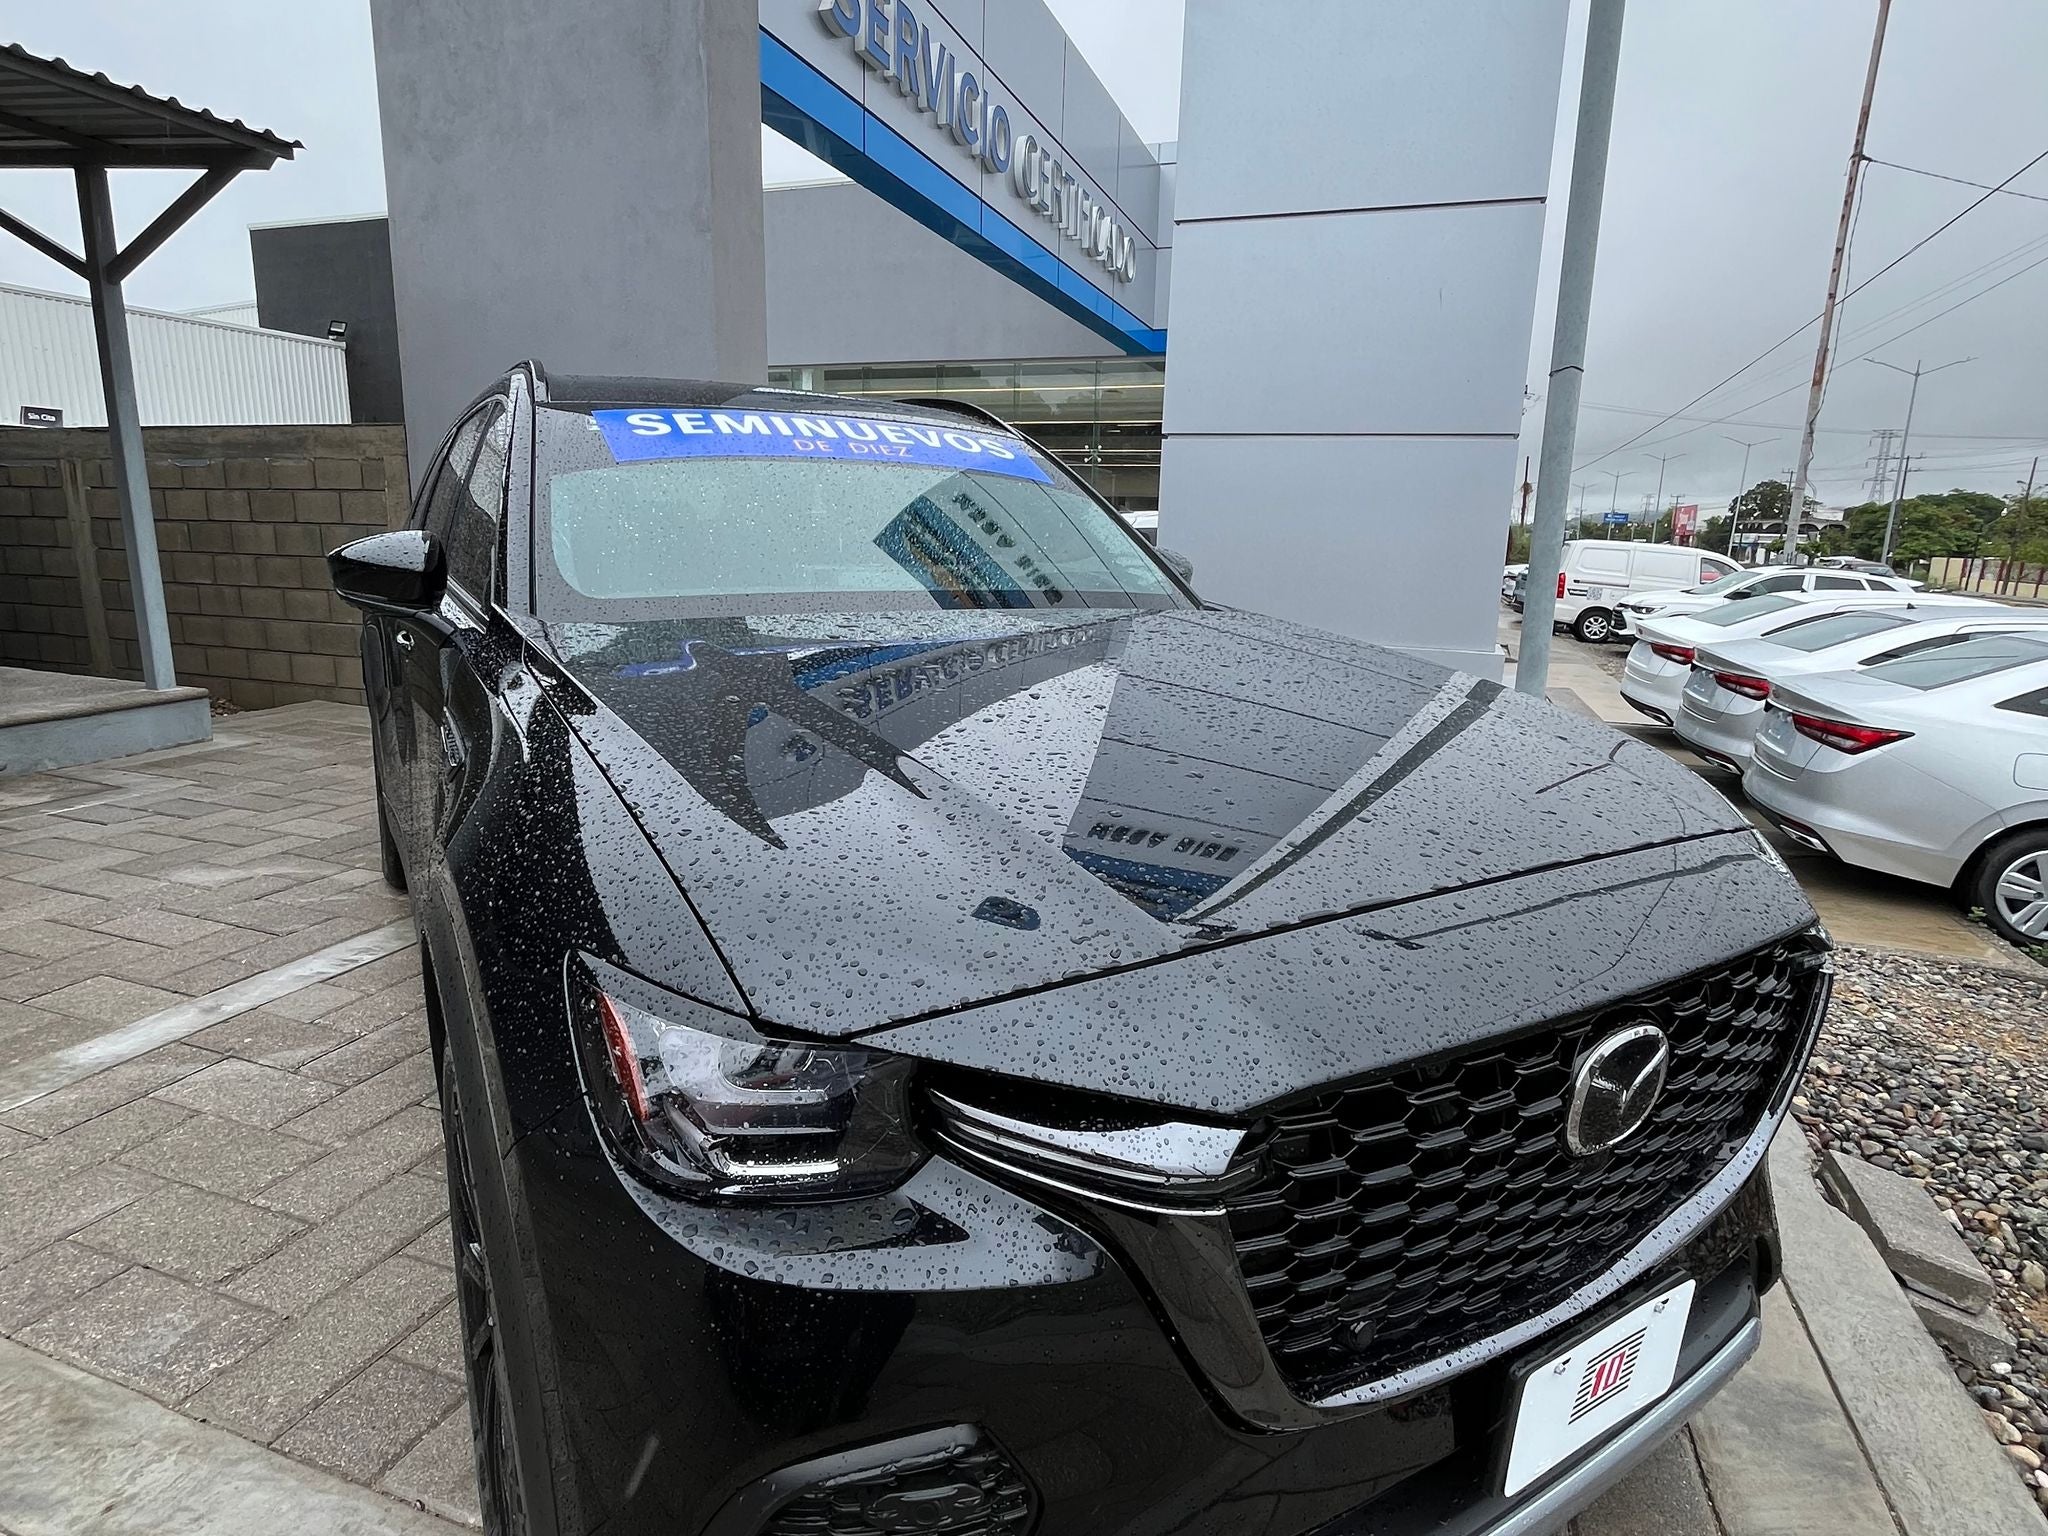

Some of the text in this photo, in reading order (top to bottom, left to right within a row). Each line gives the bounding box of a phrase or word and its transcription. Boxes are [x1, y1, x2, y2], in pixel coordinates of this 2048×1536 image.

[626, 412, 1015, 460] SEMINUEVOS
[794, 438, 912, 459] DE DIEZ
[1590, 1351, 1626, 1398] 10
